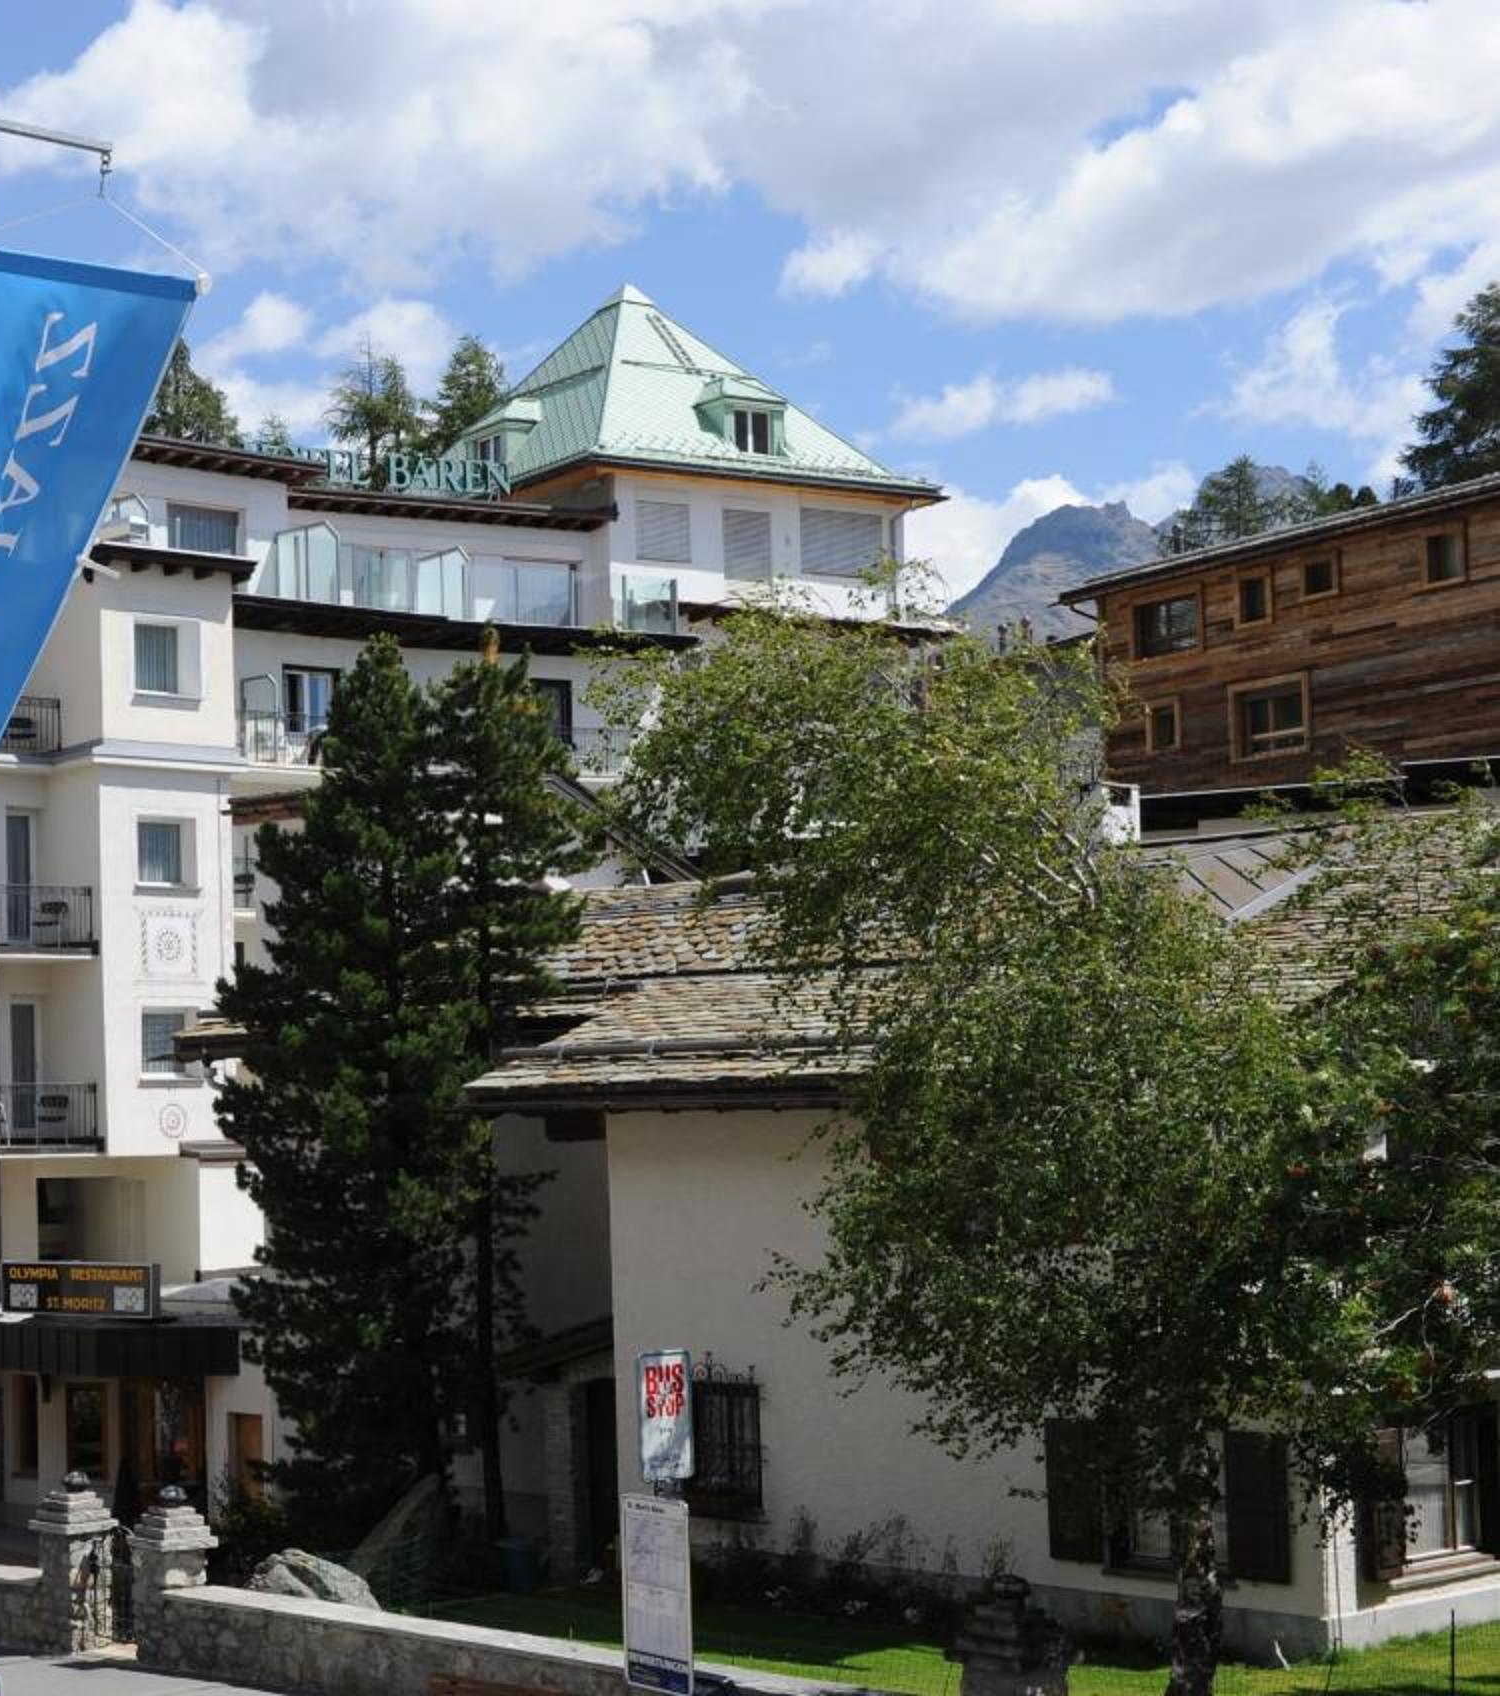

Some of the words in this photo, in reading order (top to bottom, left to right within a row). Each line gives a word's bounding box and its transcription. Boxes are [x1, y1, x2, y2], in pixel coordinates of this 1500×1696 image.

[8, 1267, 59, 1280] OLYMPIA
[69, 1267, 145, 1281] RESTAURANT
[644, 1363, 685, 1395] BUS
[645, 1393, 685, 1419] STOP
